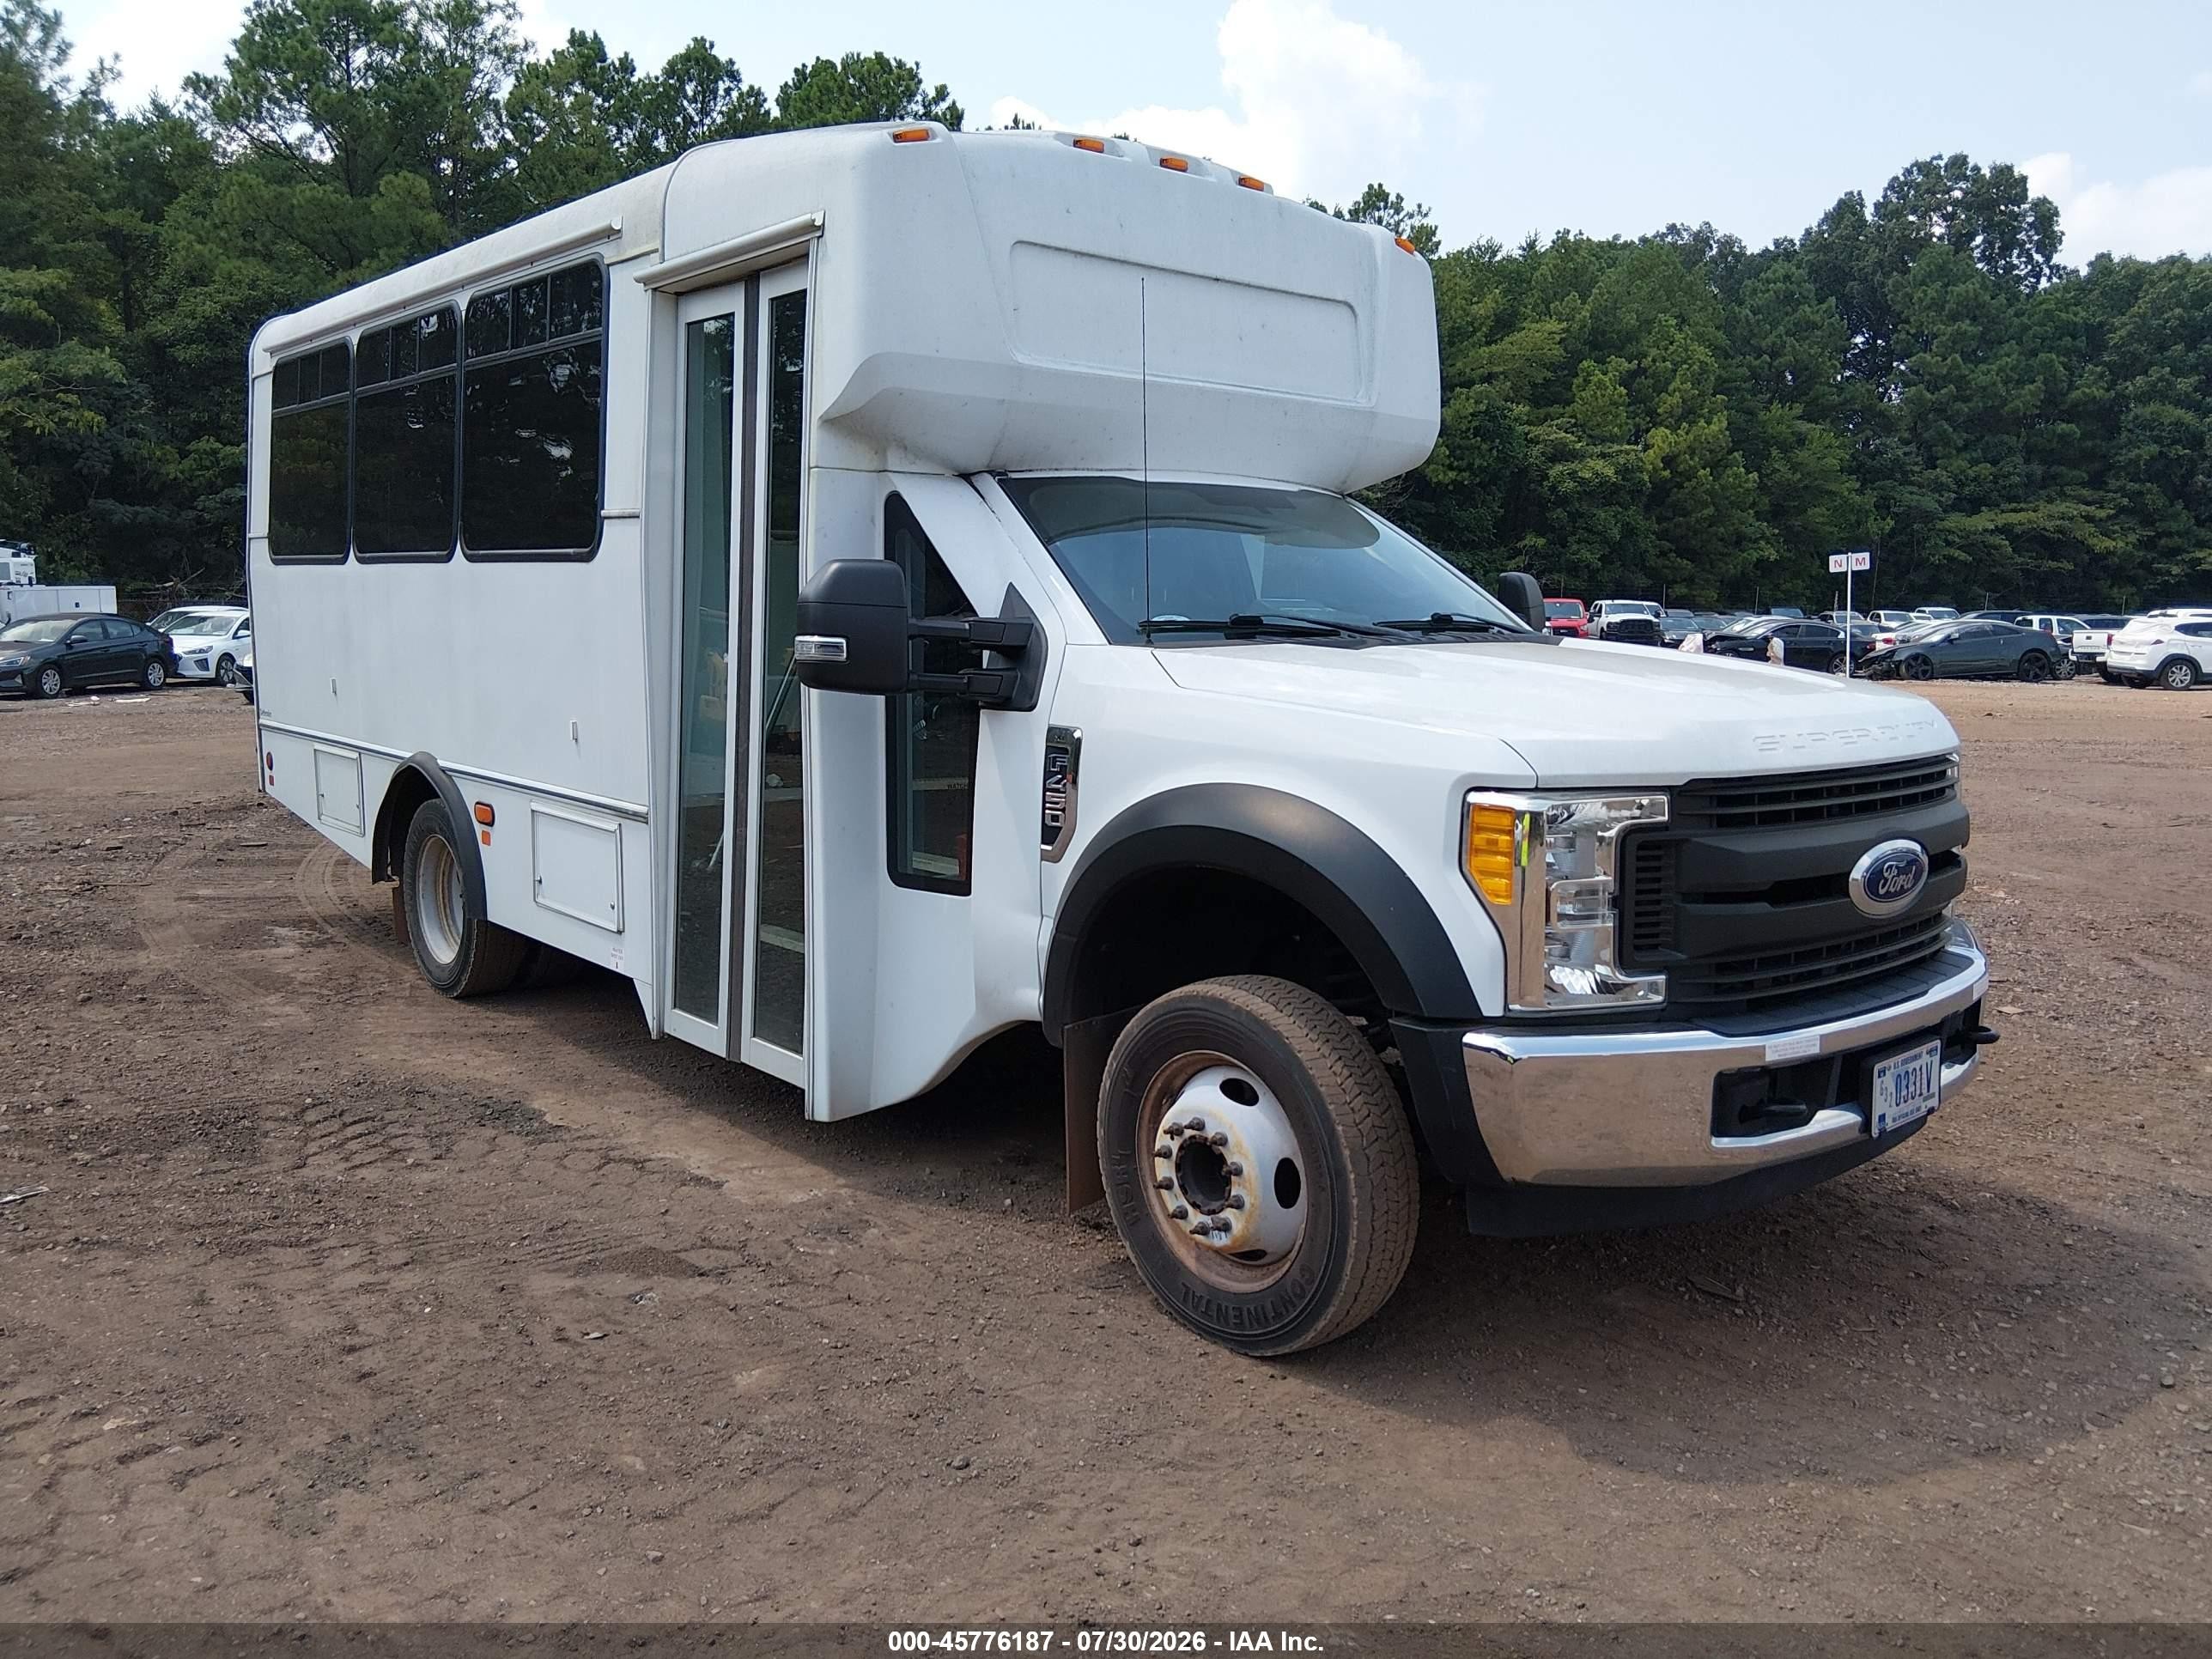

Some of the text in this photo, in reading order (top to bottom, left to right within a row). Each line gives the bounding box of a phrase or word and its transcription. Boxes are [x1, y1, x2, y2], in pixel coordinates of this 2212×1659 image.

[1833, 559, 1843, 568] N
[1855, 556, 1867, 567] M
[1752, 726, 1878, 752] SUPER
[1044, 753, 1068, 827] F450
[1878, 859, 1916, 895] Ford
[1894, 1060, 1933, 1107] 0331V
[1174, 1261, 1316, 1328] CONTINENTAL
